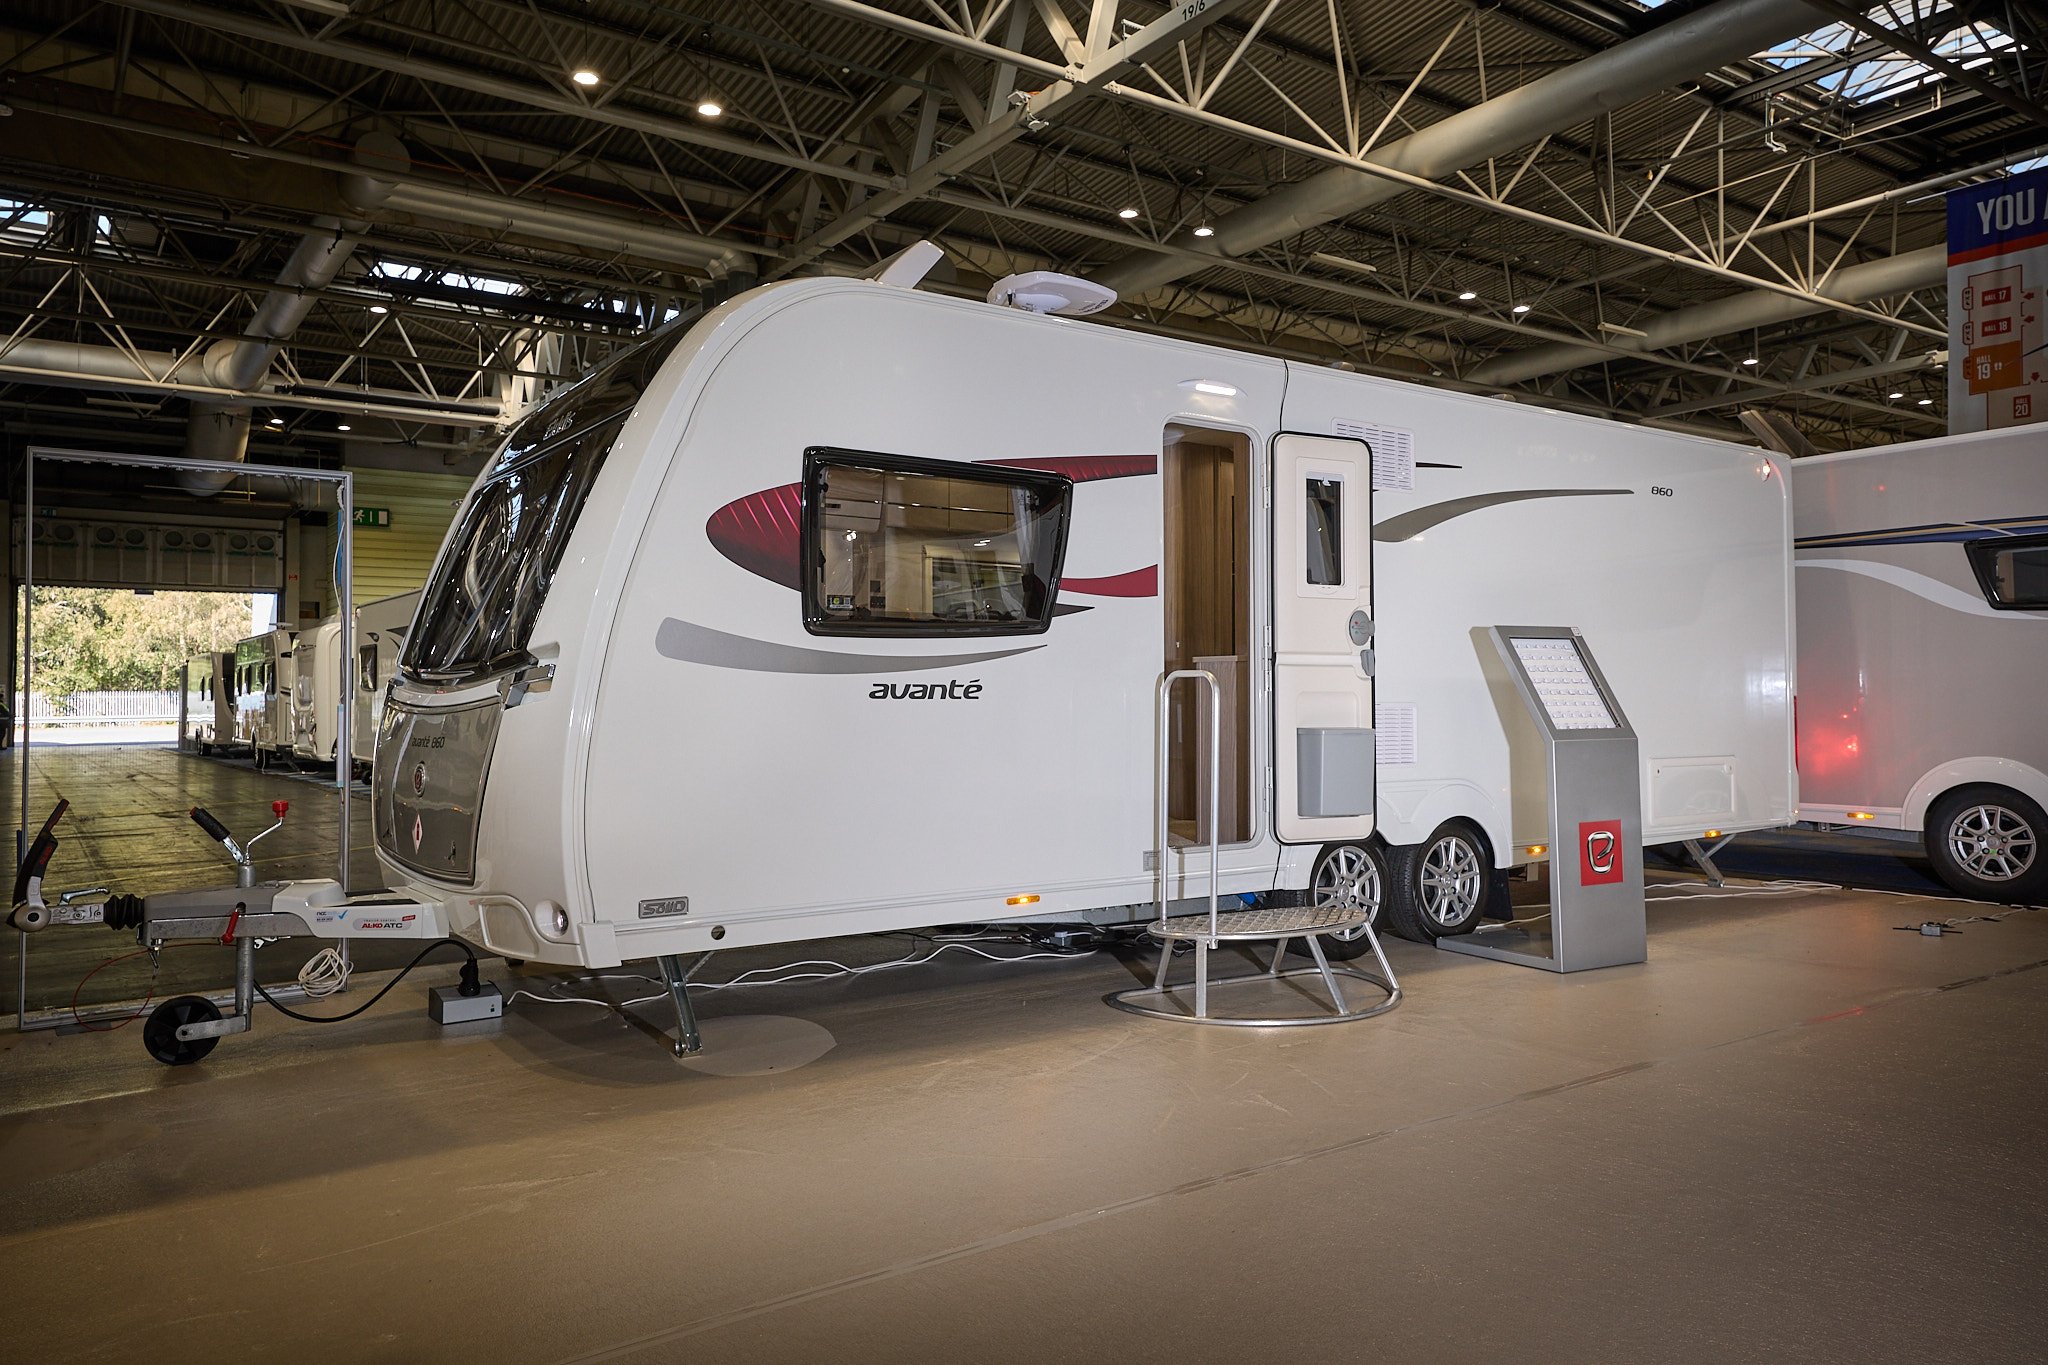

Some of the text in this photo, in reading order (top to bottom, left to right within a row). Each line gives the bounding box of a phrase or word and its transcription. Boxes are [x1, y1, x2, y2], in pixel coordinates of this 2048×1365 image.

[1182, 0, 1206, 21] 19/6
[1976, 188, 2035, 235] YOU
[1999, 290, 2007, 300] 17
[1999, 321, 2008, 331] 18
[1976, 354, 1991, 364] HALL
[1977, 363, 1991, 380] 19
[2015, 403, 2029, 417] 20
[1651, 486, 1673, 497] 860
[868, 679, 983, 700] avanté
